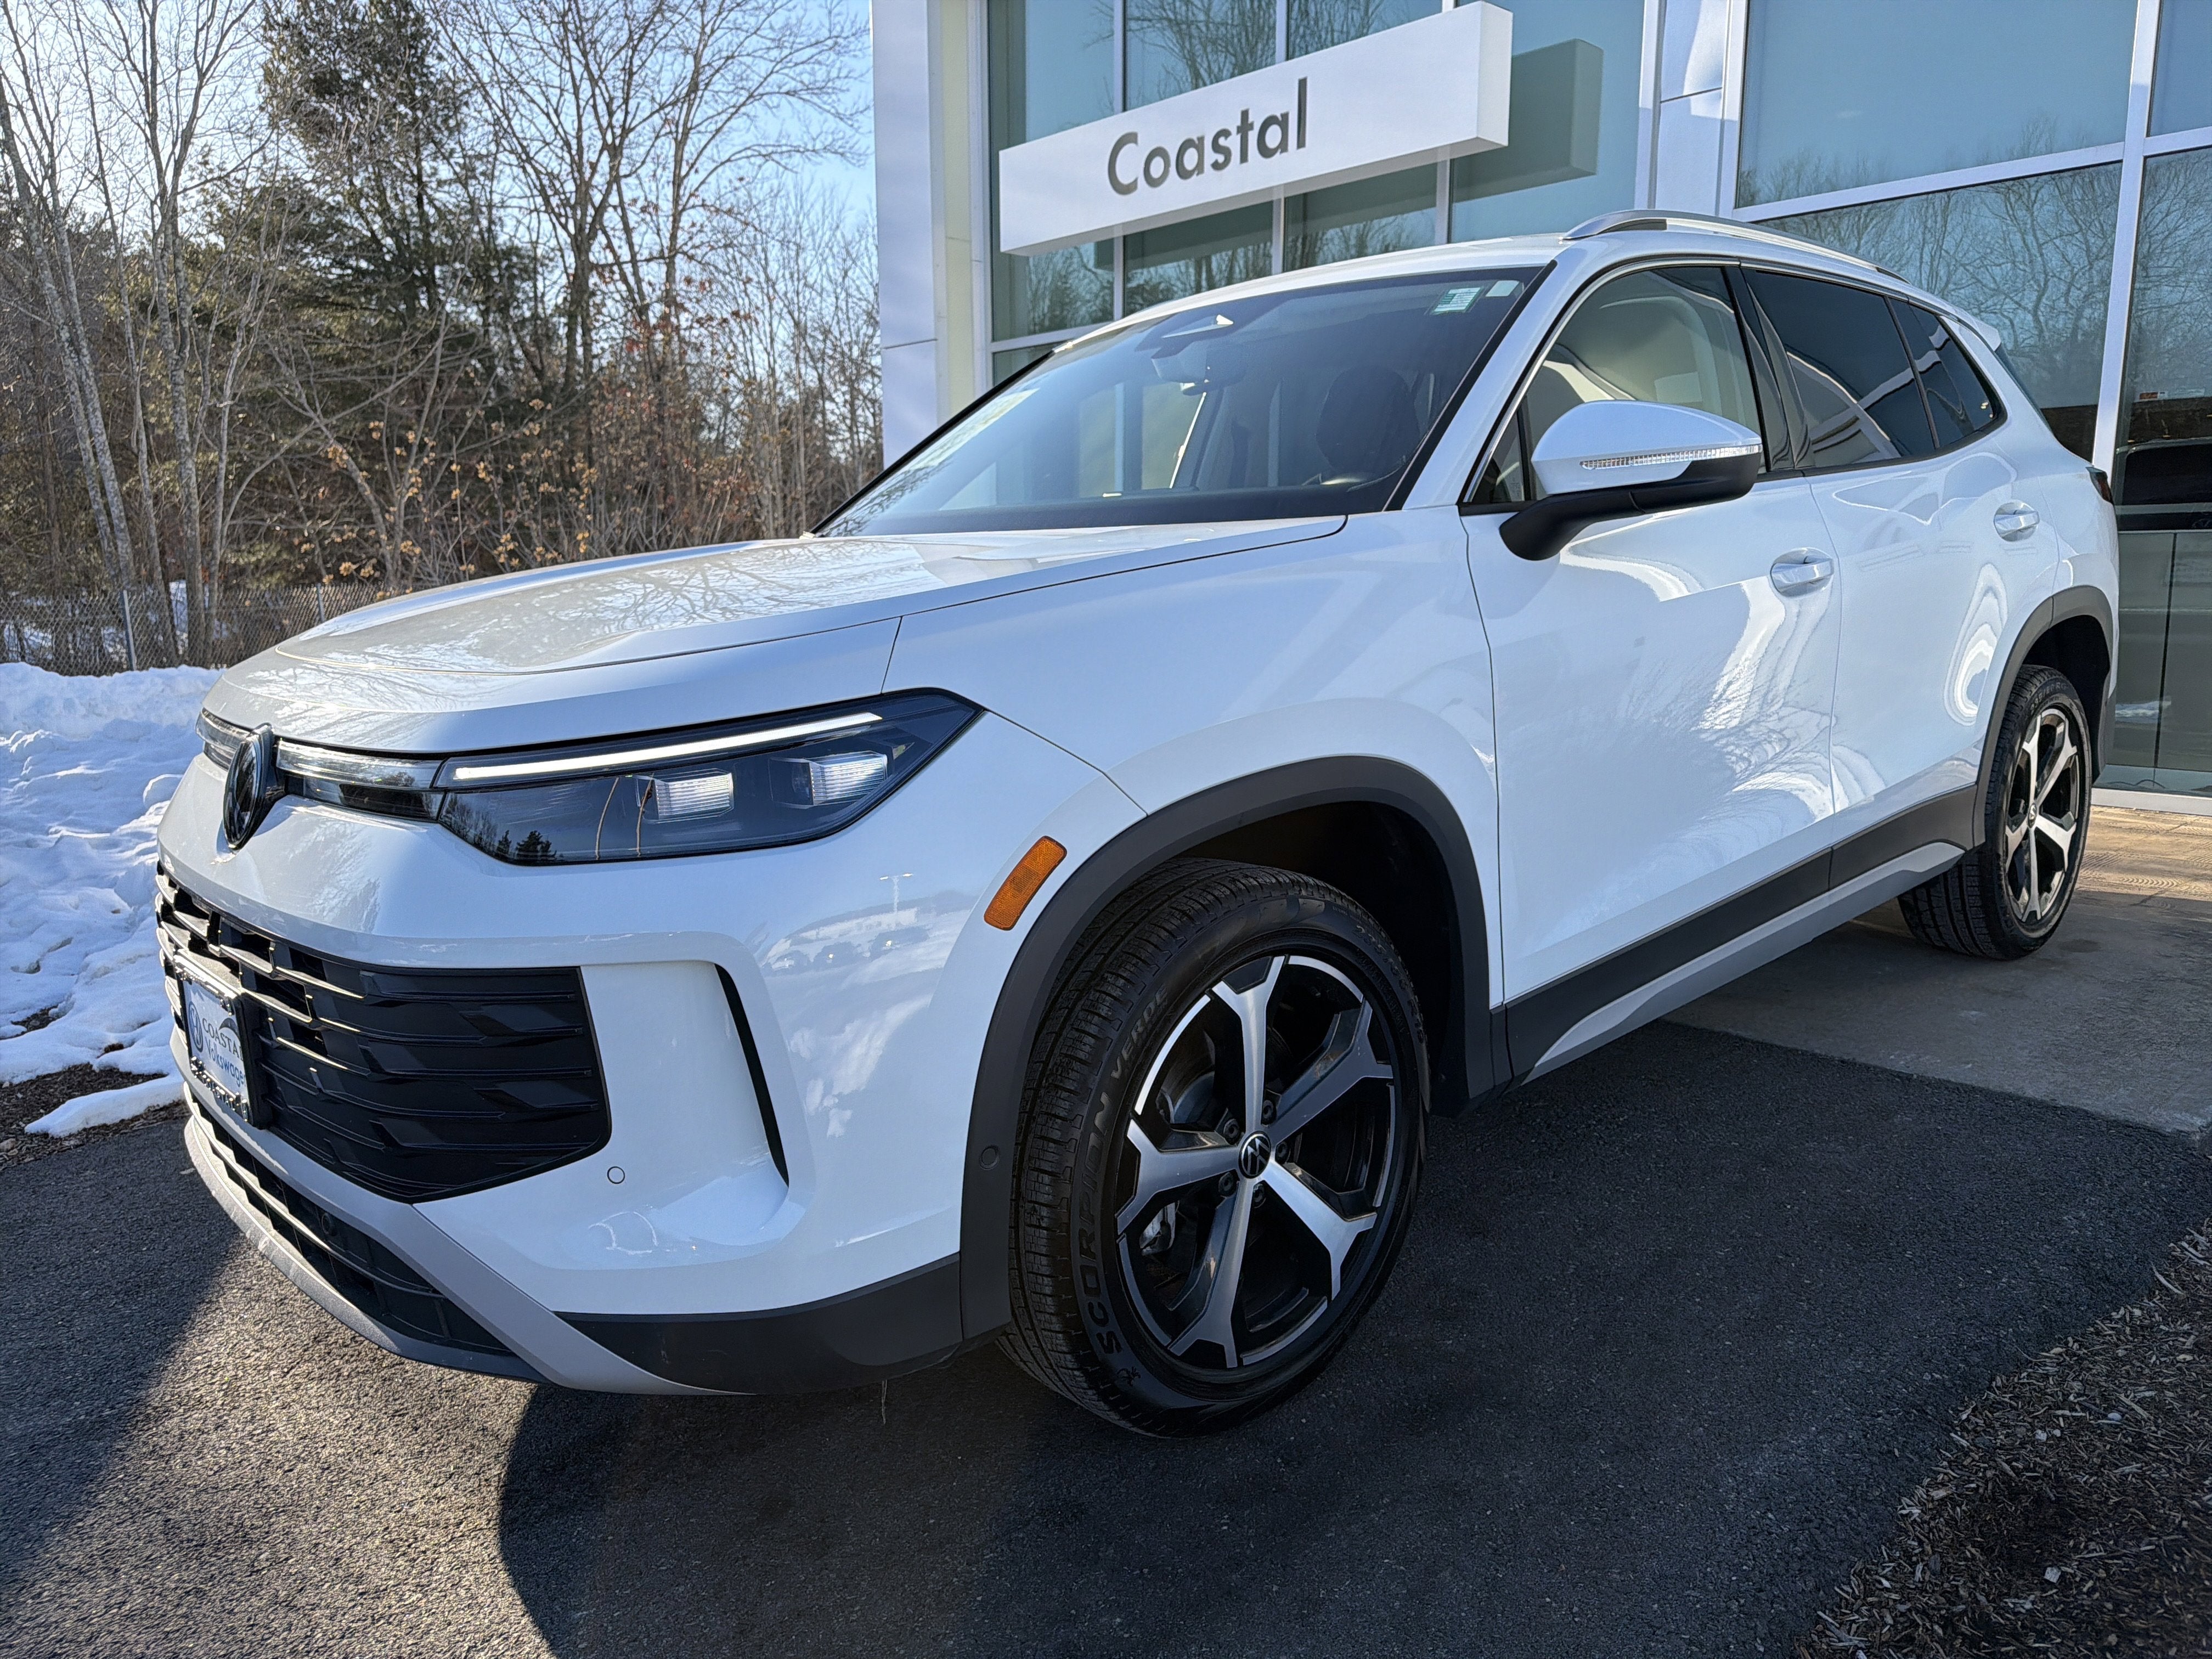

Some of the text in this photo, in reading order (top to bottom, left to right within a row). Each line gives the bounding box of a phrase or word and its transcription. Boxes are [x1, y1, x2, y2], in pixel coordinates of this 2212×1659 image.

[1107, 76, 1308, 195] Coastal
[202, 1018, 244, 1062] COASTAL
[1071, 983, 1168, 1355] SCORPION VERDE
